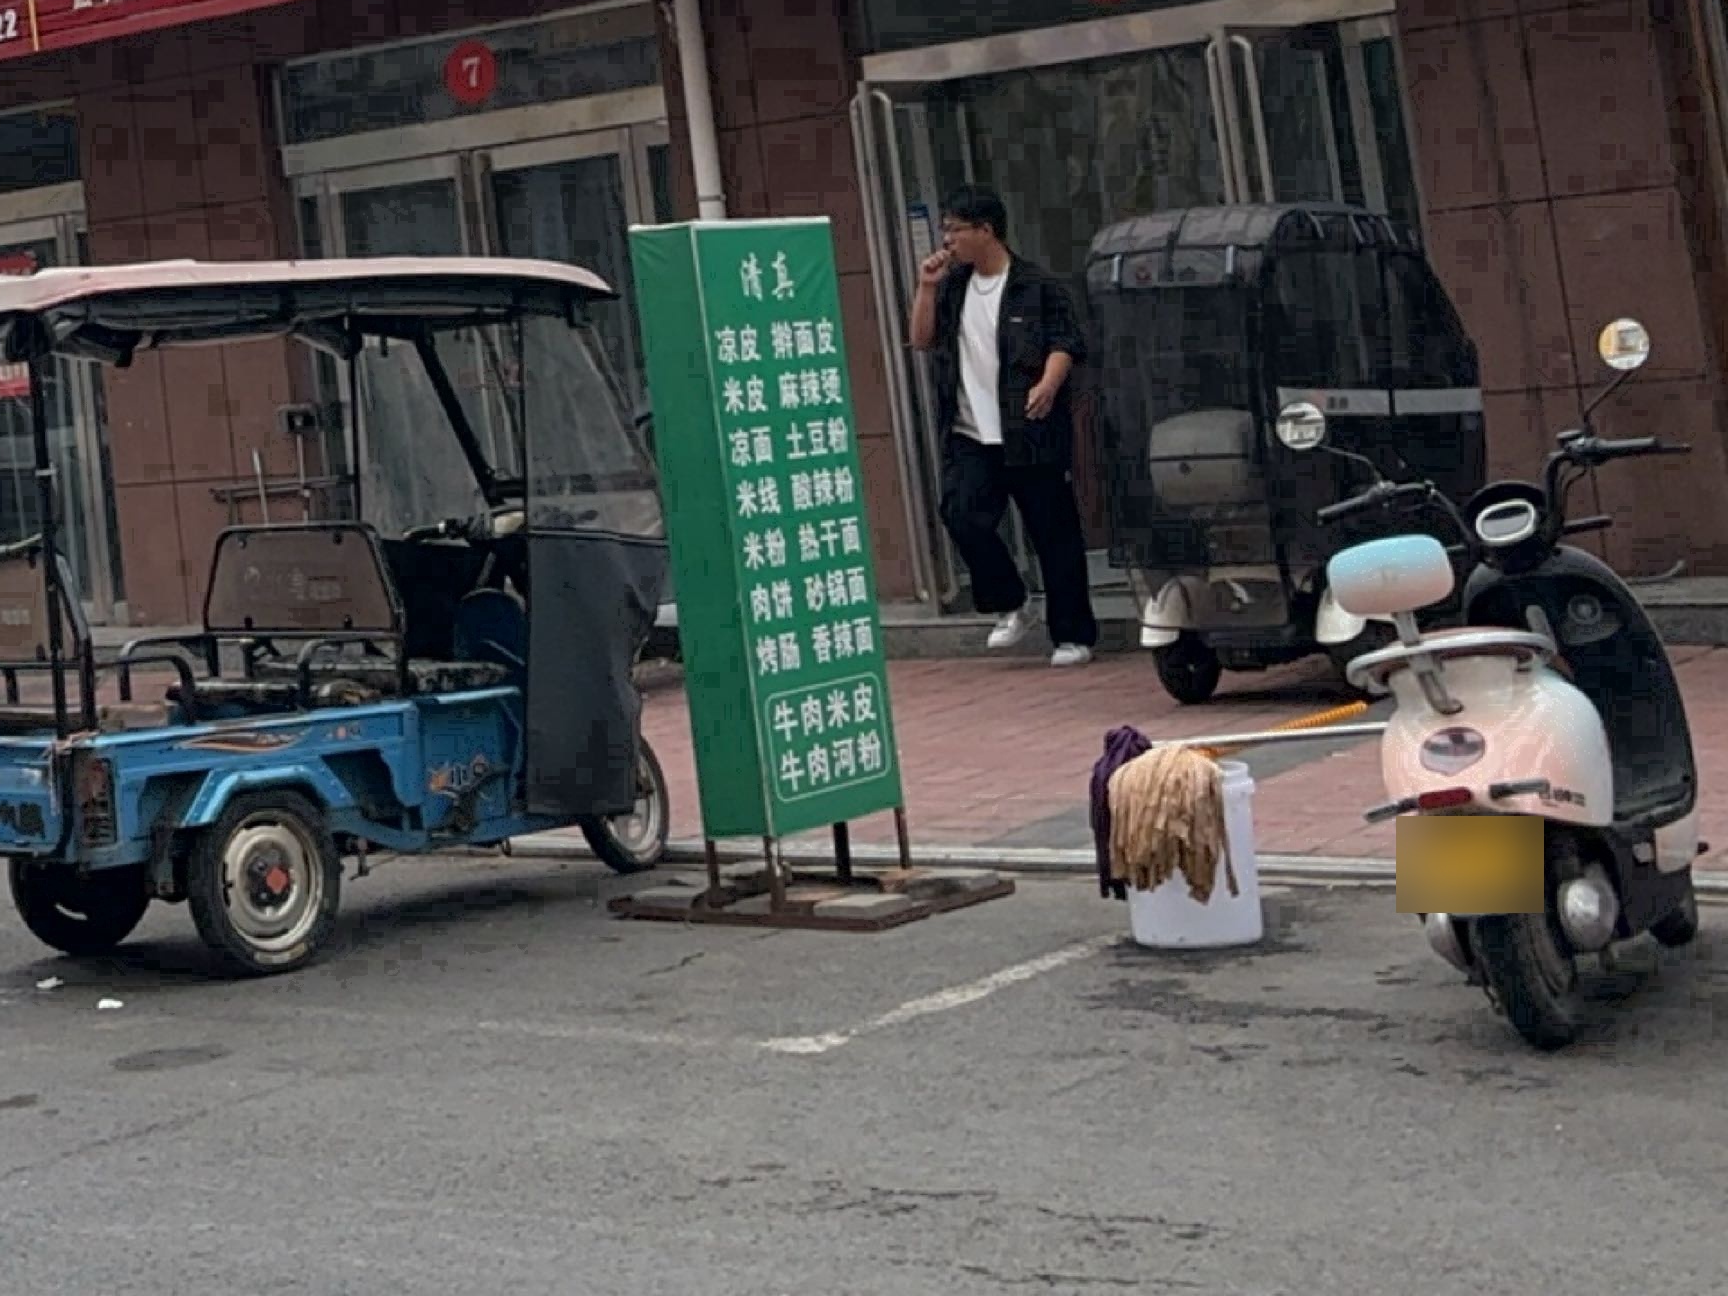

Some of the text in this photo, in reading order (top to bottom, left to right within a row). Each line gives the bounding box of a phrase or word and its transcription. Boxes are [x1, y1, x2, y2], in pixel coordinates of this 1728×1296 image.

[461, 59, 480, 88] 7
[714, 316, 837, 365] 凉皮 擀面皮
[722, 367, 844, 415] 米皮 麻辣烫
[728, 417, 849, 469] 凉面 土豆粉
[735, 466, 855, 519] 米线 酸辣粉
[743, 516, 861, 570] 米粉 热干面
[750, 566, 868, 624] 肉饼 砂锅面
[755, 617, 874, 676] 烤肠 香辣面
[771, 681, 878, 743] 牛肉米皮
[778, 732, 882, 794] 牛肉河粉
